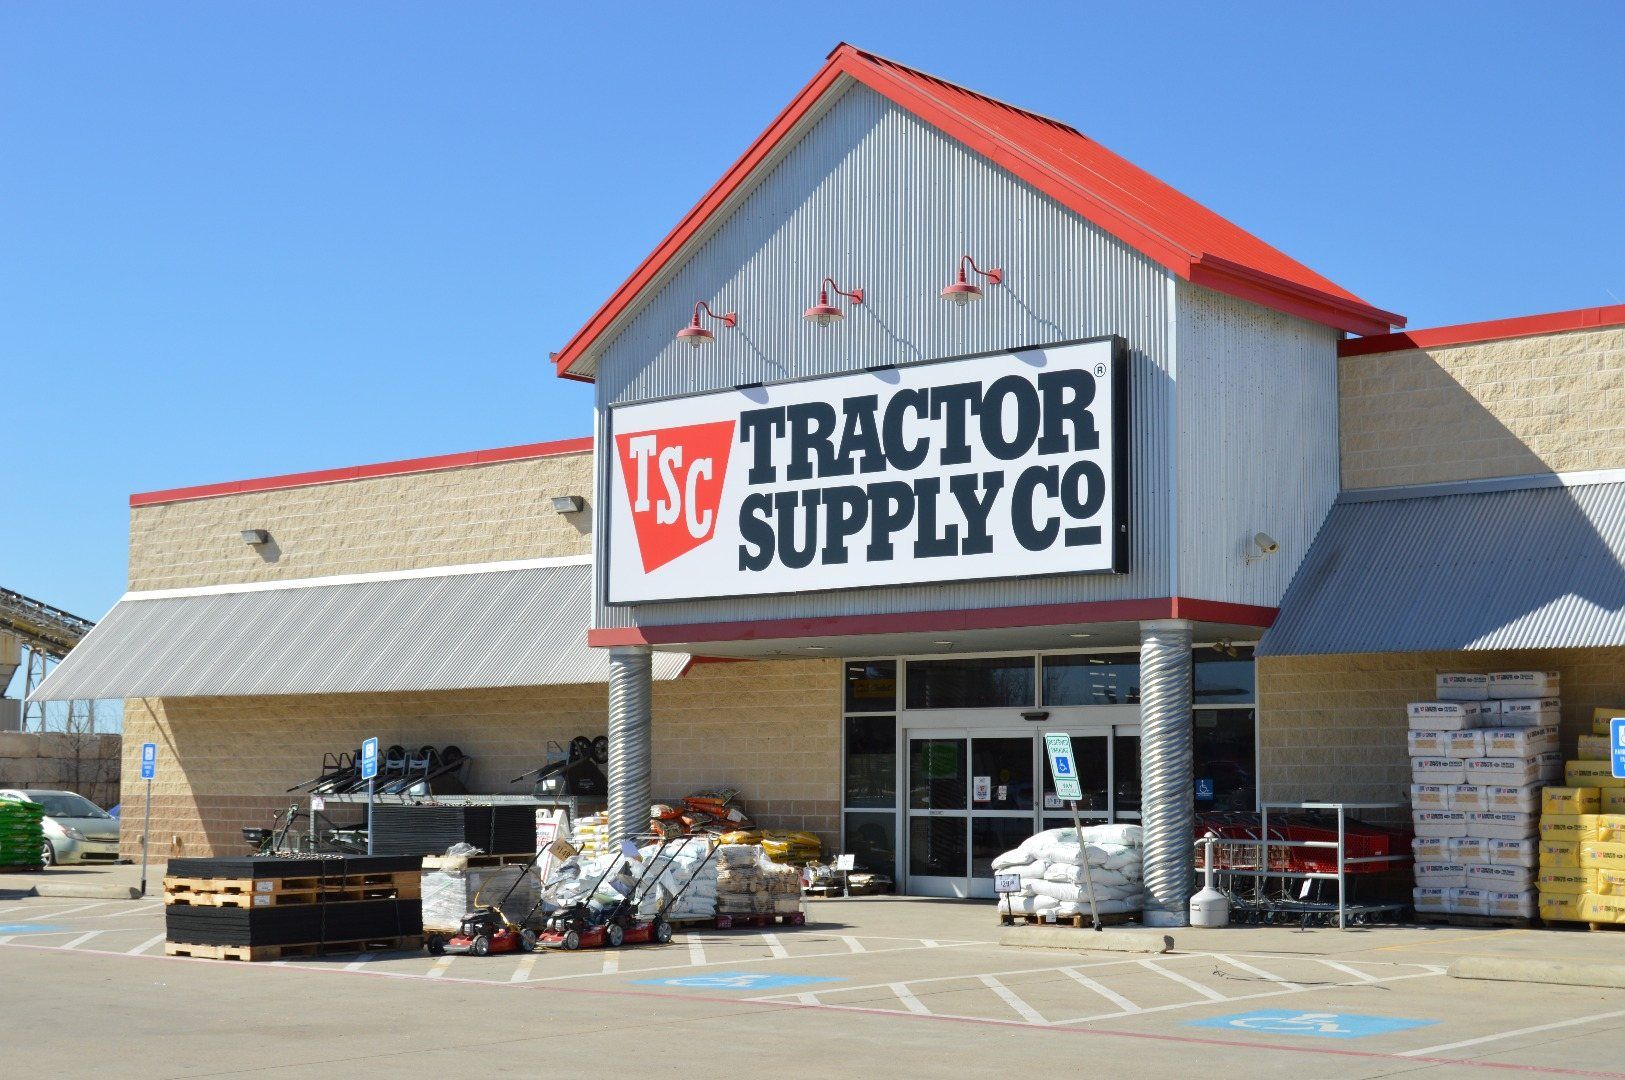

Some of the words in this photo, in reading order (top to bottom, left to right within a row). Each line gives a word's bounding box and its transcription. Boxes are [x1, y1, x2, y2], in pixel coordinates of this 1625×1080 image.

[739, 369, 1100, 485] TRACTOR
[629, 435, 714, 539] TSC
[739, 471, 1004, 572] SUPPLY
